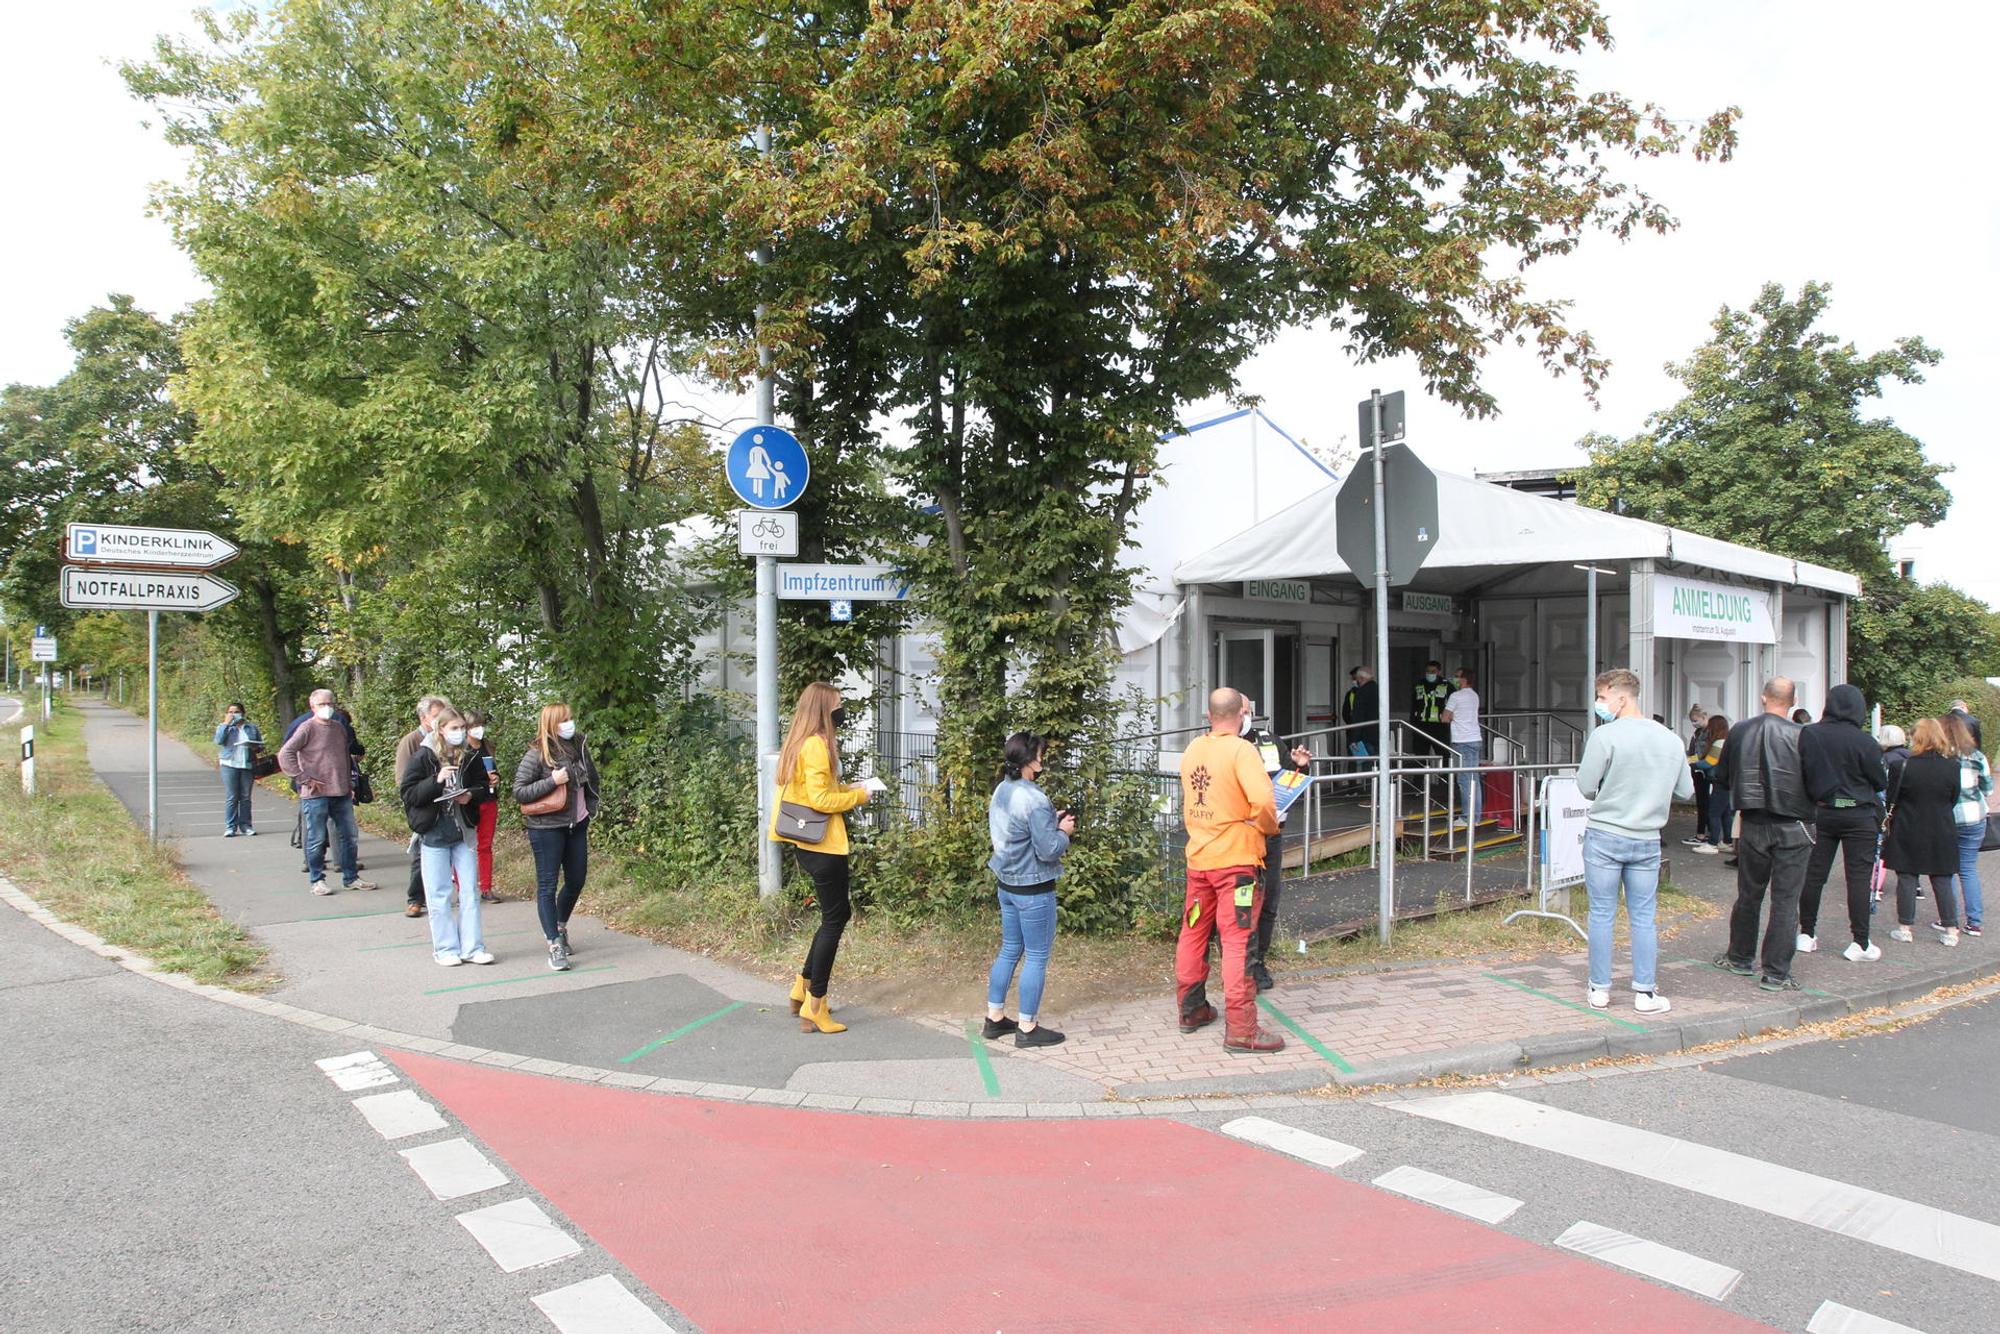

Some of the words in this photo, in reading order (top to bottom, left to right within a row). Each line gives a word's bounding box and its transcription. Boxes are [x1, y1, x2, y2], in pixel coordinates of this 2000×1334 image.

[77, 531, 95, 553] P
[101, 533, 214, 551] KINDERKLINIK
[101, 546, 141, 555] Deutsches
[759, 540, 778, 551] frei
[77, 580, 200, 600] NOTFALLPRAXIS
[783, 571, 885, 595] Impfzentrum
[1249, 580, 1305, 601] EINGANG
[1405, 594, 1450, 612] AUSGANG
[1672, 585, 1752, 624] ANMELDUNG
